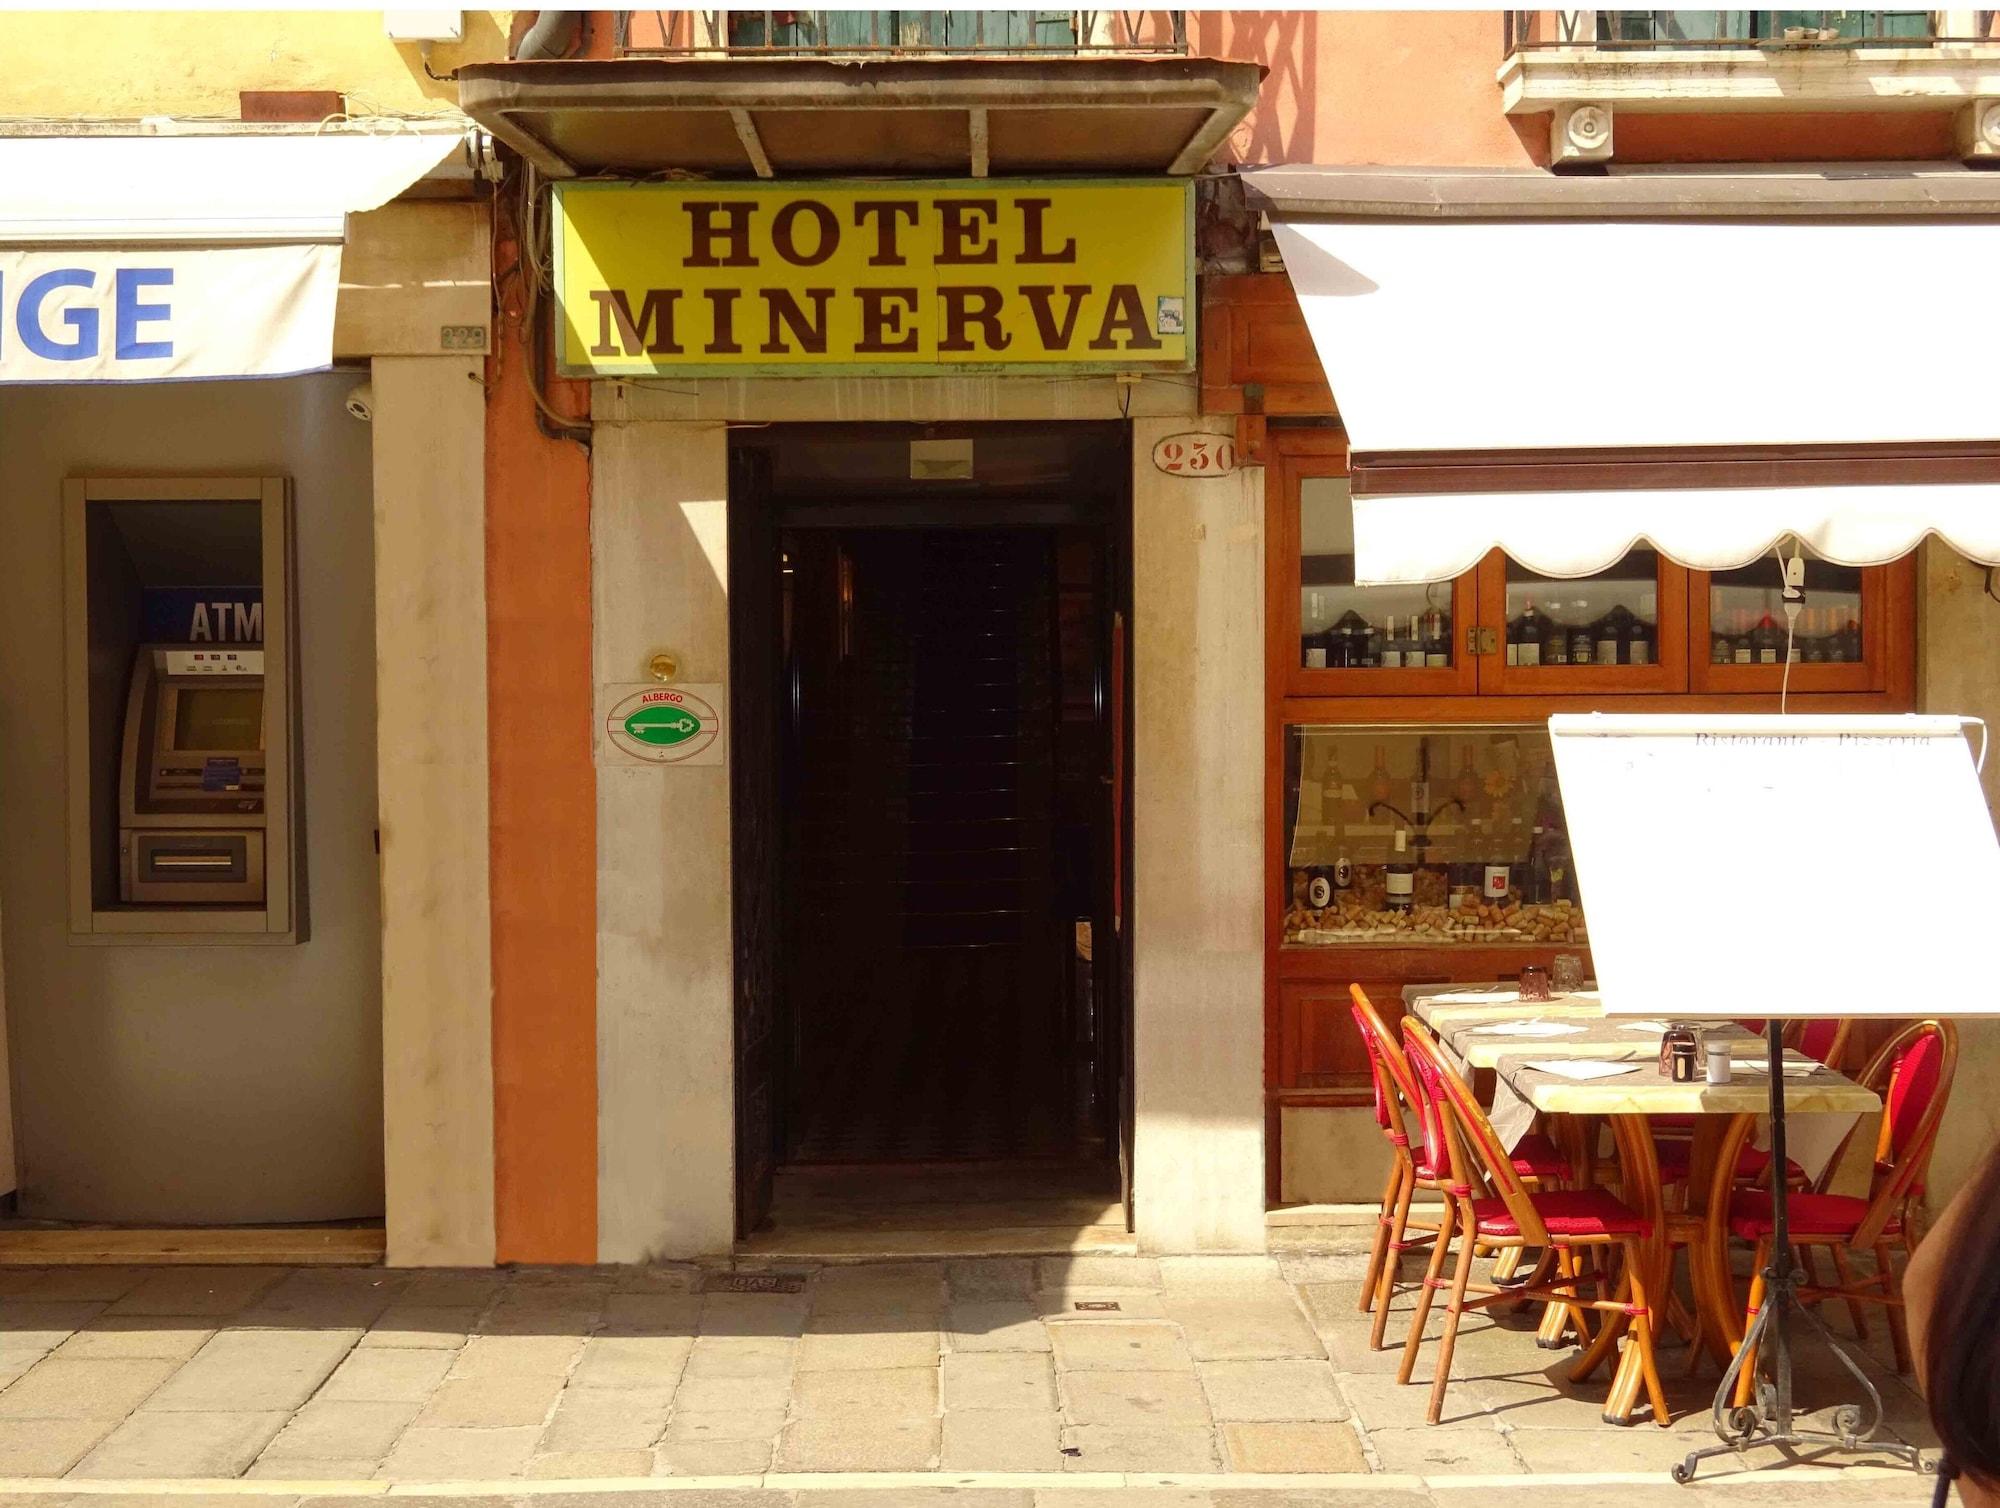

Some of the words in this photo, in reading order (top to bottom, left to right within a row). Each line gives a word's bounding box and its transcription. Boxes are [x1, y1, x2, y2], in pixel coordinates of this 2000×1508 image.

[682, 197, 1077, 268] HOTEL
[0, 267, 175, 362] GE
[588, 284, 1163, 357] MINERVA
[1163, 442, 1235, 471] 230
[189, 602, 263, 642] ATM
[641, 692, 684, 704] ALBERGO
